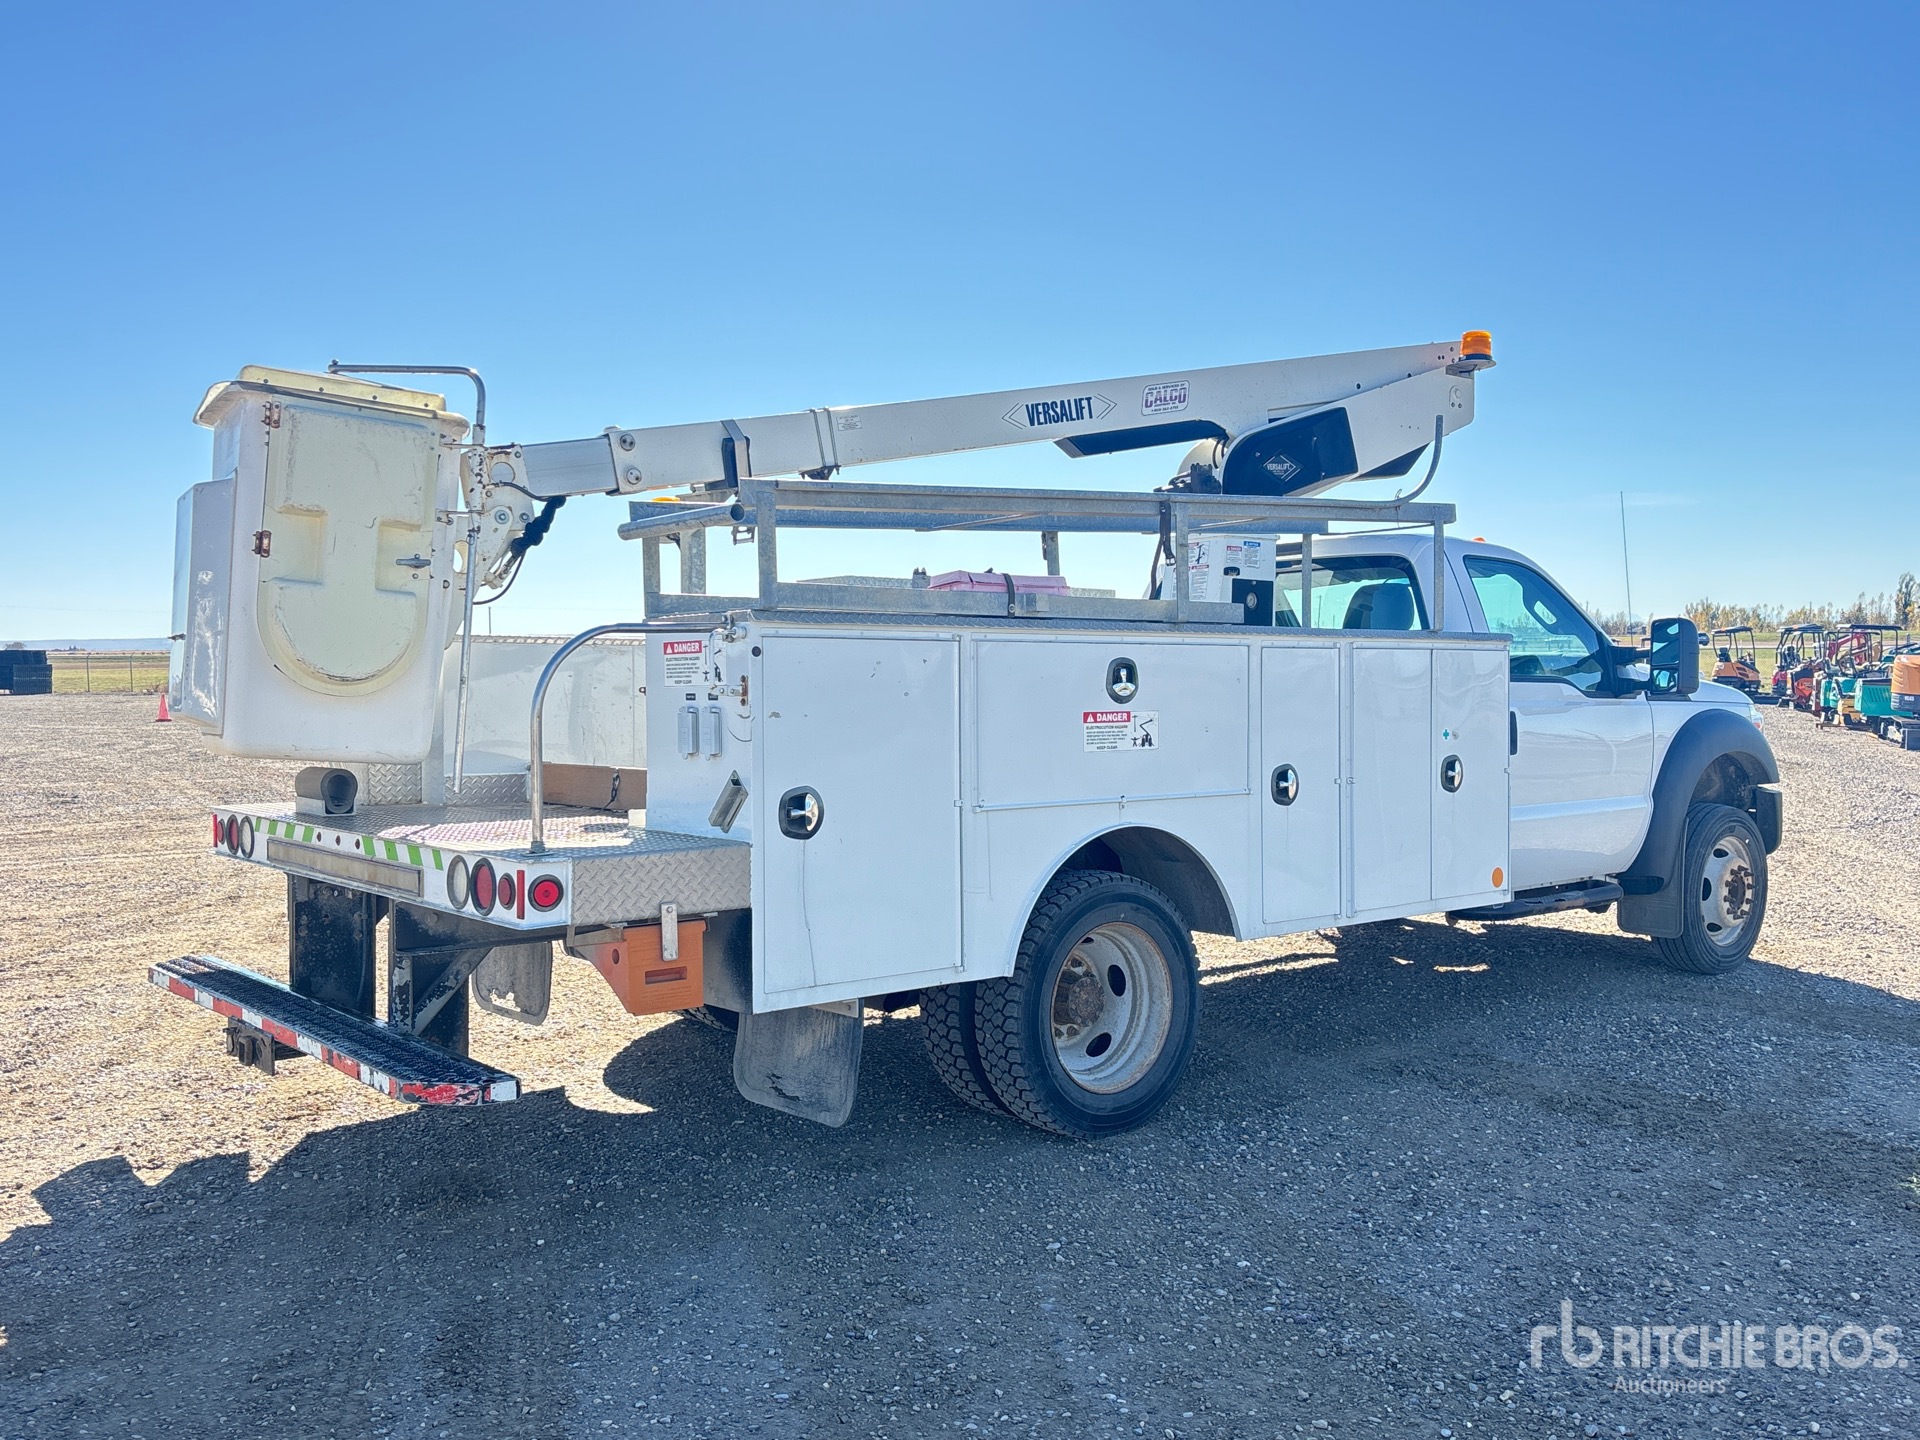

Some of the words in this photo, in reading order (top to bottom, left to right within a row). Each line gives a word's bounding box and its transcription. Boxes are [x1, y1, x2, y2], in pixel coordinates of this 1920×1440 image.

[1144, 387, 1188, 409] CALCO
[1025, 396, 1093, 427] VERSALIFT
[1266, 463, 1290, 471] VERSALIFT
[674, 642, 700, 653] DANGER
[1096, 712, 1128, 722] DANGER
